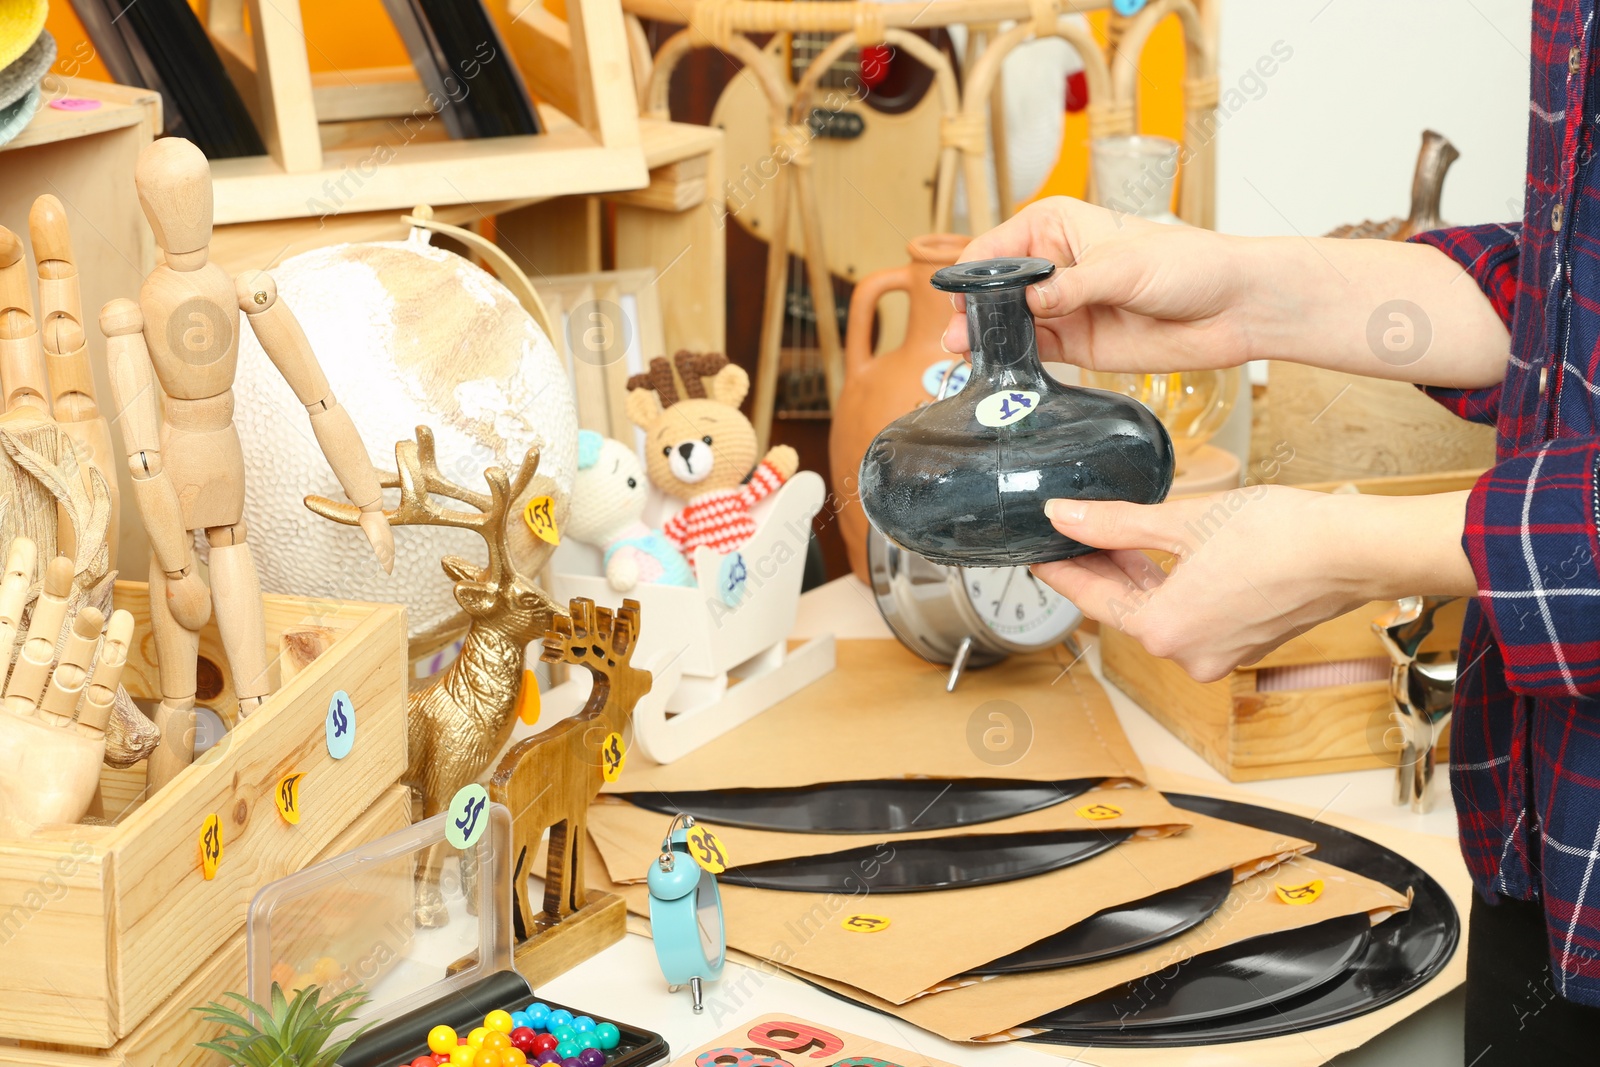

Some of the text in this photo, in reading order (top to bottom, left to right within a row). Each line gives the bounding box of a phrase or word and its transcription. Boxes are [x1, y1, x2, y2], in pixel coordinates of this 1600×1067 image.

[991, 601, 1002, 618] 7
[1015, 602, 1025, 621] 6
[455, 796, 487, 842] 3$
[690, 827, 727, 869] 3$
